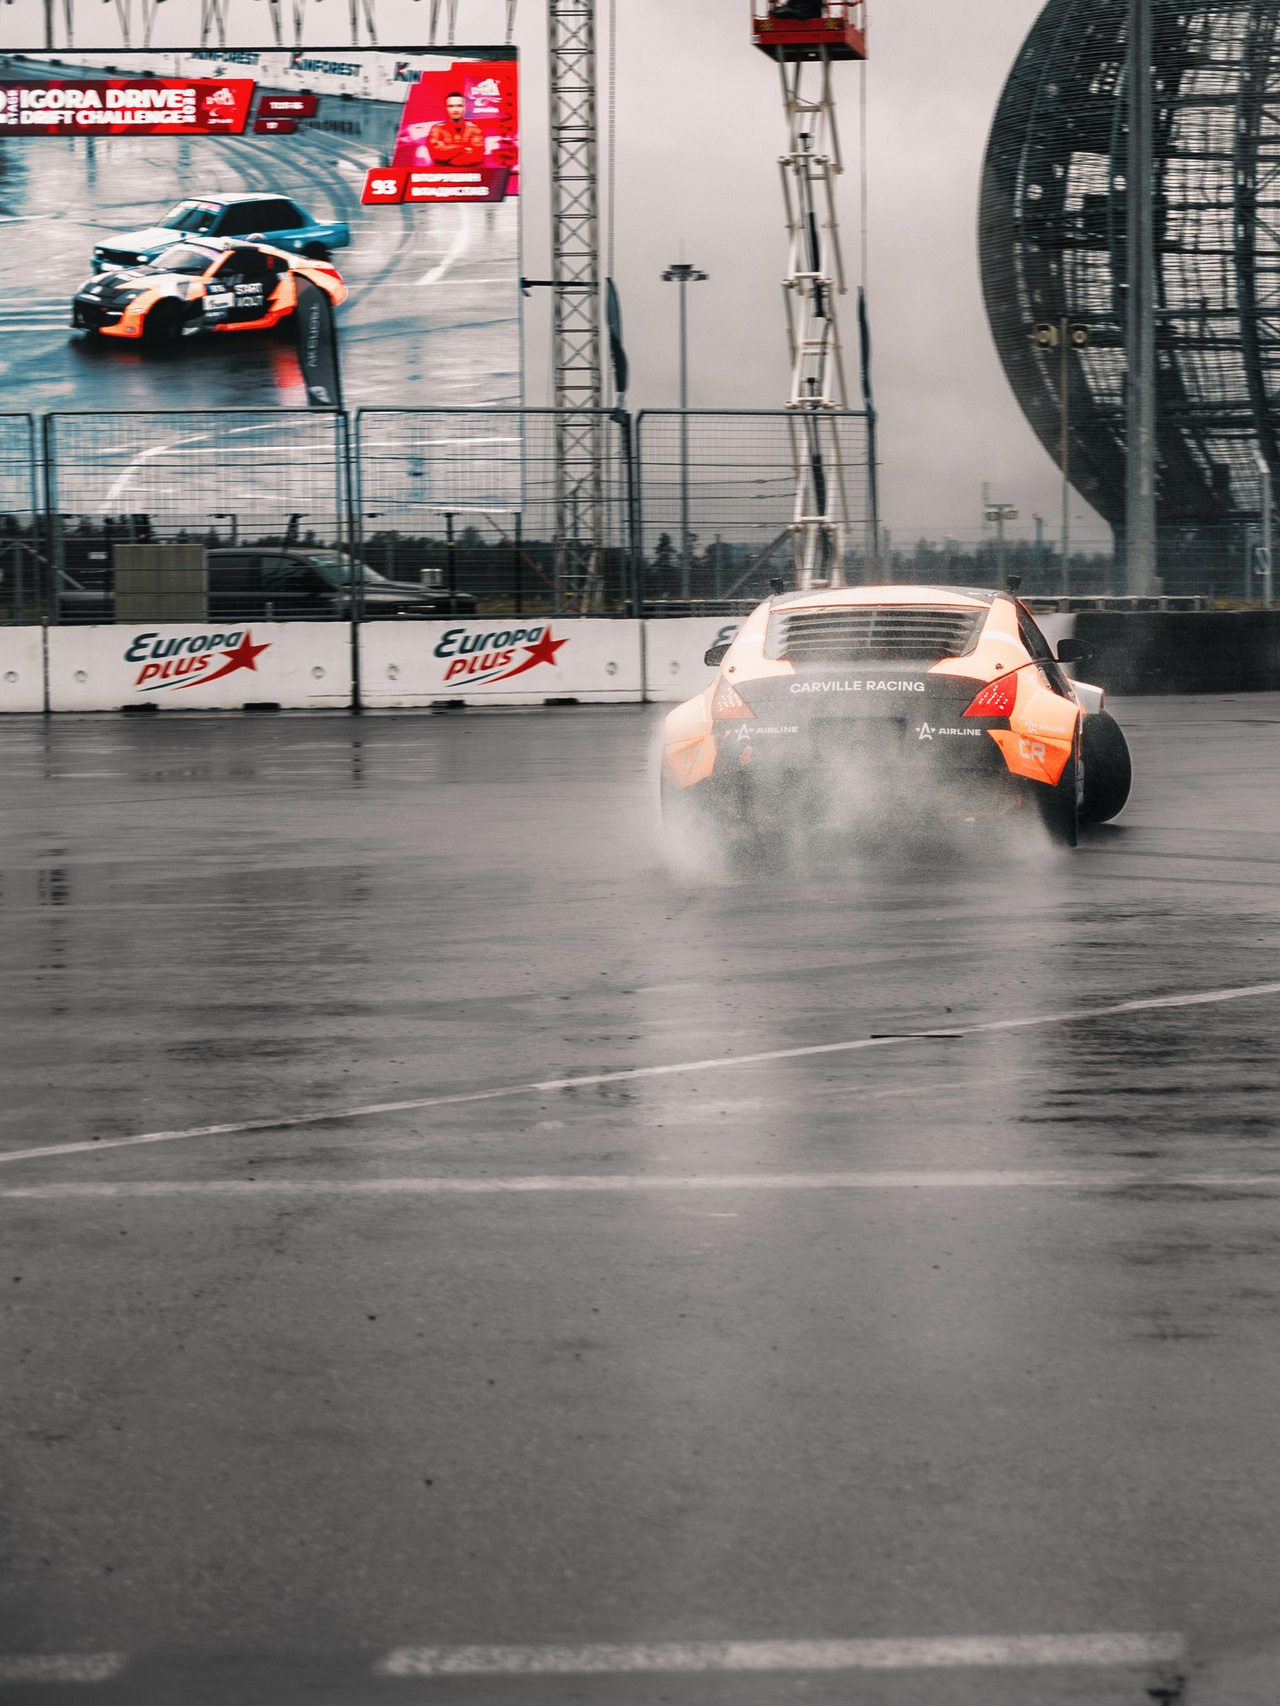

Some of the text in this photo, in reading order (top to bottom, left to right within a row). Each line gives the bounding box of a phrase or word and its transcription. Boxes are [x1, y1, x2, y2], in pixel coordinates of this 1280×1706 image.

[20, 89, 103, 109] IGORA
[105, 89, 183, 108] DRIVE
[20, 110, 183, 124] DRIFT CHALLENGE
[371, 180, 398, 195] 93
[125, 631, 244, 662] Europa
[434, 626, 544, 658] Europa
[790, 681, 925, 694] CARVILLE RACING
[756, 726, 799, 735] AIRLINE
[938, 727, 982, 736] AIRLINE
[1018, 739, 1046, 763] CR
